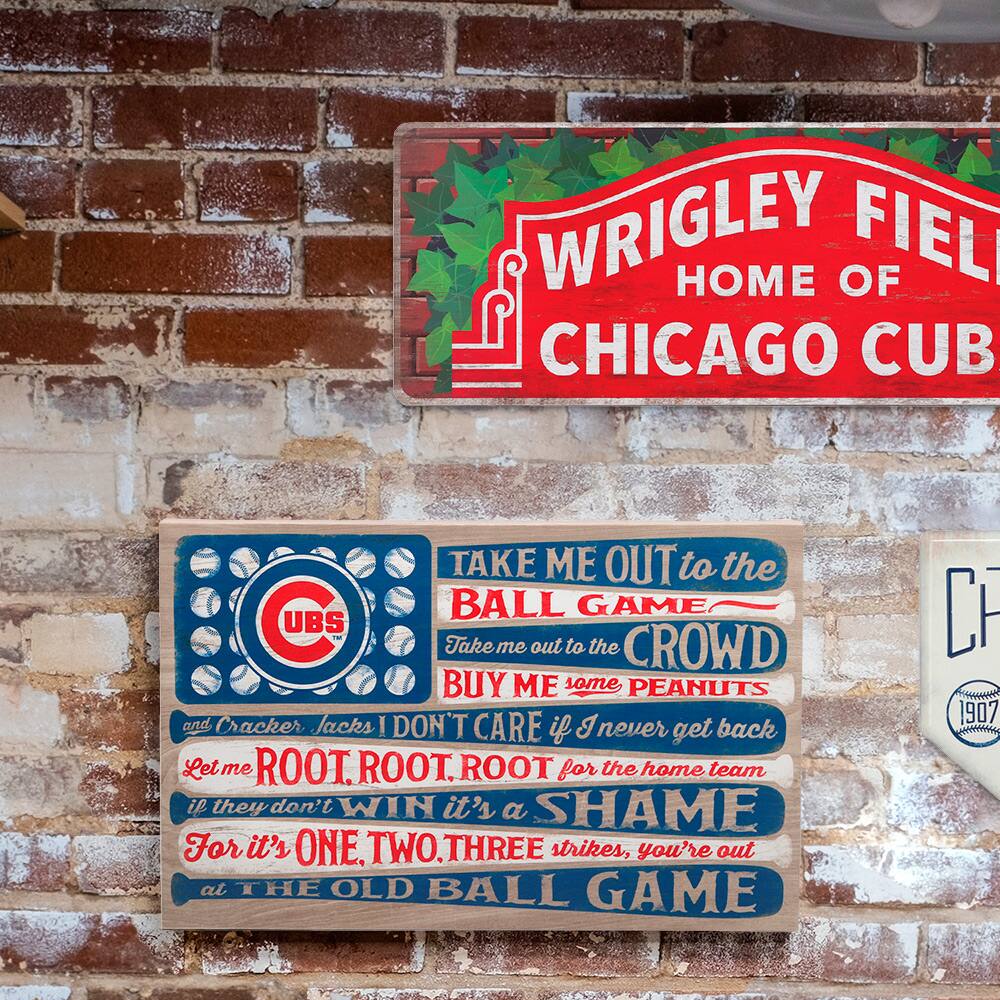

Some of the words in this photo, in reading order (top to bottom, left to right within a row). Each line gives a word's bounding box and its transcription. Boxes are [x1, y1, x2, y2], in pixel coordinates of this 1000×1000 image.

[537, 170, 824, 292] WRIGLEY
[677, 264, 814, 297] HOME
[839, 264, 900, 297] OF
[539, 321, 839, 376] CHICAGO
[448, 548, 537, 579] TAKE
[545, 546, 598, 582] ME
[605, 544, 678, 586] OUT
[679, 553, 717, 581] to
[719, 551, 780, 581] the
[262, 581, 344, 663] CUBS
[450, 587, 565, 621] BALL
[577, 594, 709, 616] GAME
[445, 634, 495, 655] Take
[495, 640, 528, 655] me
[527, 637, 565, 655] out
[565, 638, 587, 655] to
[587, 637, 621, 655] the
[623, 622, 780, 671] CROWD
[443, 668, 510, 699] BUY
[512, 673, 559, 698] ME
[565, 677, 623, 693] some
[628, 678, 769, 699] PEANUTS
[182, 717, 213, 733] and
[215, 714, 303, 736] Cracker
[378, 715, 387, 738] I
[392, 713, 469, 740] DON'T
[473, 710, 542, 743] CARE
[549, 713, 573, 745] if
[575, 713, 599, 740] I
[597, 720, 669, 738] never
[672, 717, 714, 746] get
[716, 717, 778, 739] back
[959, 699, 999, 726] 1907
[182, 757, 224, 781] Let
[223, 763, 254, 776] me
[460, 753, 555, 781] ROOT
[557, 758, 600, 781] for
[601, 759, 639, 777] the
[640, 760, 706, 778] home
[708, 761, 767, 777] team
[187, 798, 208, 818] if
[212, 799, 269, 818] they
[336, 795, 438, 819] WIN
[502, 801, 529, 820] a
[532, 787, 759, 833] SHAME
[183, 832, 246, 862] For
[443, 833, 545, 861] THREE
[551, 838, 631, 860] strikes,
[717, 841, 756, 859] out
[200, 881, 229, 897] at
[235, 880, 321, 897] THE
[330, 877, 414, 899] OLD
[426, 873, 571, 906] BALL
[586, 870, 758, 914] GAME
